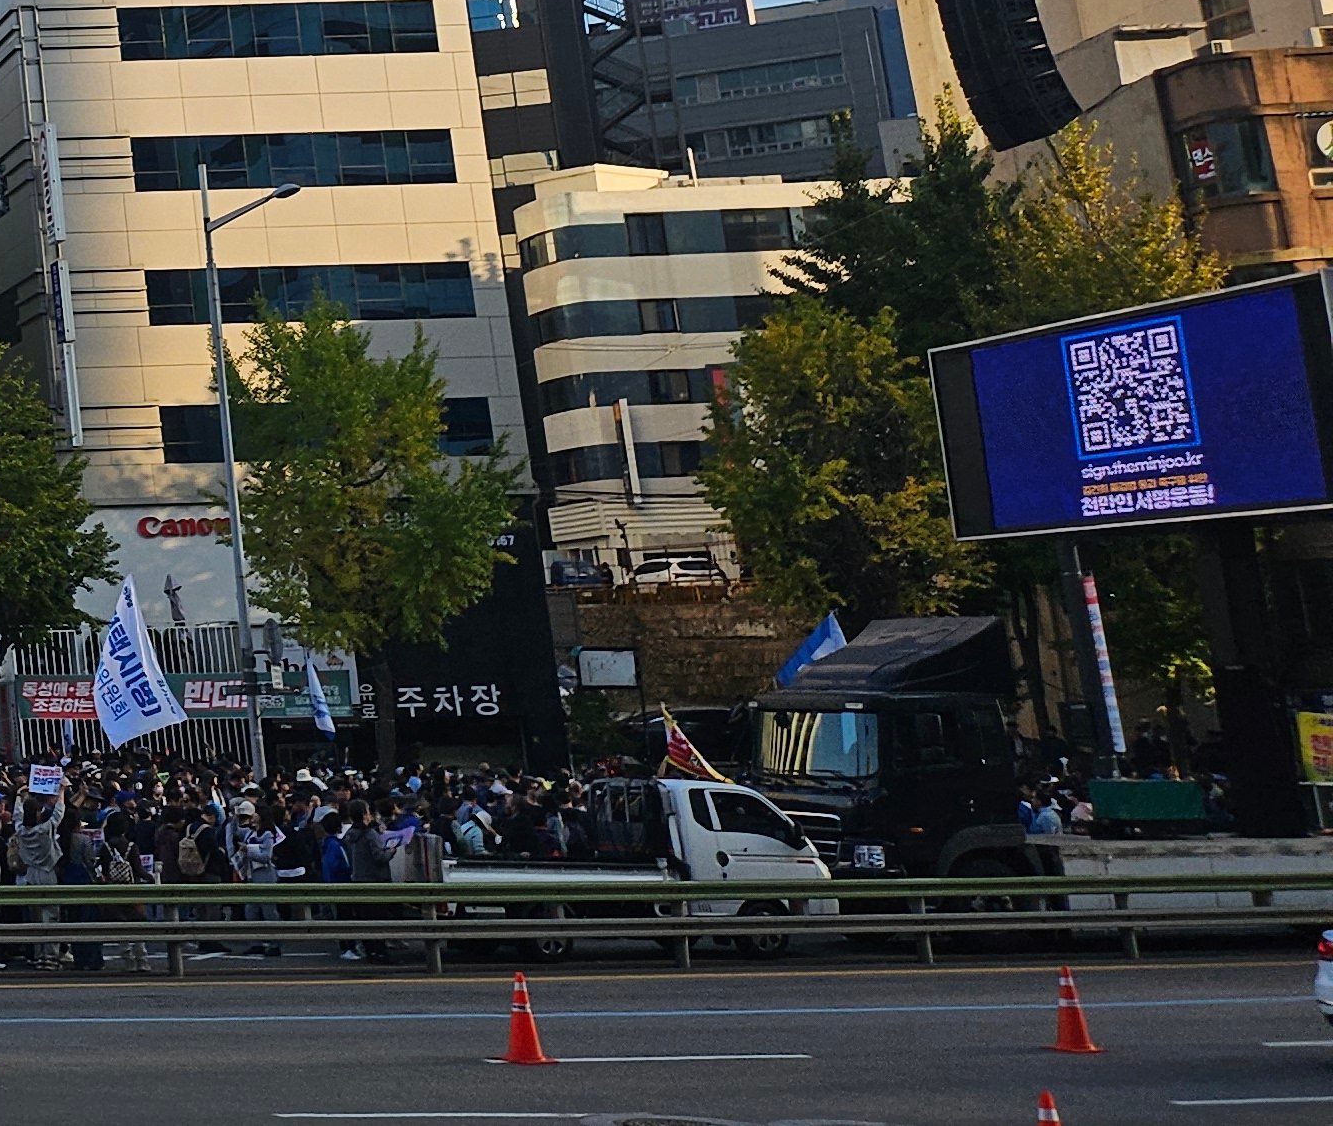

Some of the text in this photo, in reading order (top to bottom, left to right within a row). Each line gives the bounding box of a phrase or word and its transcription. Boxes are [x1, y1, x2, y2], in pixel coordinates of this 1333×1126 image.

[137, 516, 231, 539] Canon
[22, 681, 95, 698] 동성애·동
[98, 666, 132, 722] 위원회
[359, 683, 379, 719] 유료
[396, 682, 501, 718] 주차장
[32, 698, 94, 714] 조장하는
